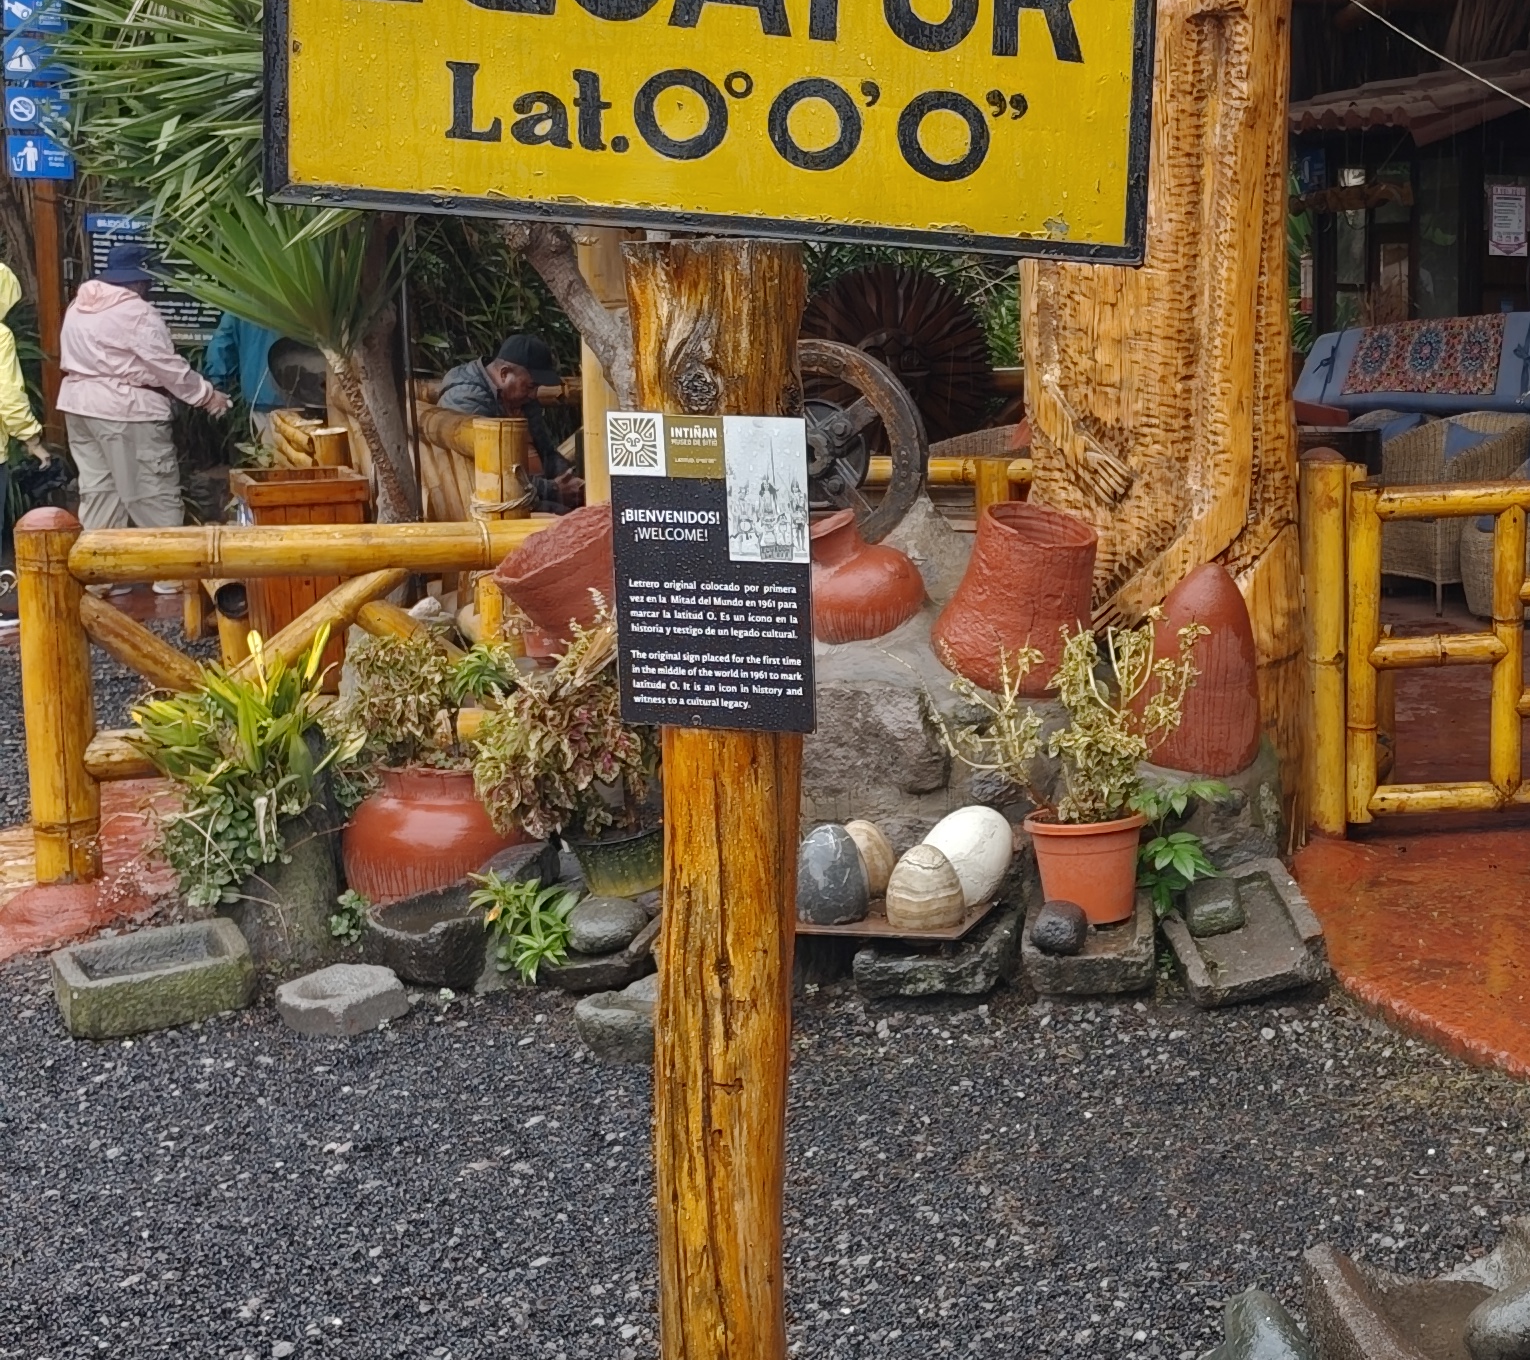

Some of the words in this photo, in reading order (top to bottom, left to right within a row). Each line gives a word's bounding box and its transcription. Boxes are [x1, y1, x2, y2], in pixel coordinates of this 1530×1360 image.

[670, 425, 718, 439] INTIÑAN
[620, 508, 721, 525] ¡BIENVENIDOS!
[633, 526, 709, 543] ¡WELCOME!
[628, 578, 660, 589] Letrero
[663, 580, 697, 591] original
[700, 581, 740, 592] colocado
[744, 584, 760, 595] por
[763, 583, 797, 595] primera
[629, 595, 644, 603] vez
[658, 594, 667, 604] la
[670, 595, 697, 605] Mitad
[698, 596, 712, 606] del
[713, 596, 744, 607] Mundo
[745, 599, 756, 607] en
[758, 599, 776, 609] 1961
[777, 601, 798, 611] para
[630, 610, 660, 618] marcar
[662, 609, 671, 619] la
[674, 609, 703, 620] latitud
[720, 612, 731, 621] Es
[733, 614, 745, 622] un
[775, 616, 787, 624] en
[789, 614, 798, 624] la
[665, 626, 671, 636] y
[673, 625, 703, 637] testigo
[704, 626, 716, 636] de
[717, 628, 729, 636] un
[730, 627, 760, 639] legado
[761, 629, 799, 639] cultural.
[630, 649, 647, 659] The
[648, 650, 681, 662] original
[682, 652, 700, 663] sign
[701, 652, 731, 664] placed
[731, 653, 744, 664] for
[746, 654, 761, 664] the
[762, 655, 781, 665] first
[782, 656, 802, 666] time
[631, 664, 640, 674] in
[641, 664, 656, 674] the
[657, 665, 686, 676] middle
[687, 666, 697, 676] of
[698, 667, 713, 677] the
[714, 668, 739, 678] world
[740, 669, 749, 679] in
[750, 670, 768, 680] 1961
[769, 672, 779, 680] to
[780, 671, 803, 681] mark
[632, 679, 667, 690] latitude
[683, 682, 691, 691] It
[693, 681, 701, 691] is
[704, 684, 716, 692] an
[718, 682, 738, 693] icon
[740, 683, 749, 693] in
[752, 684, 783, 697] history
[785, 686, 803, 696] and
[633, 693, 666, 704] witness
[667, 697, 678, 705] to
[678, 697, 685, 706] a
[686, 697, 720, 707] cultural
[720, 697, 751, 710] legacy.
